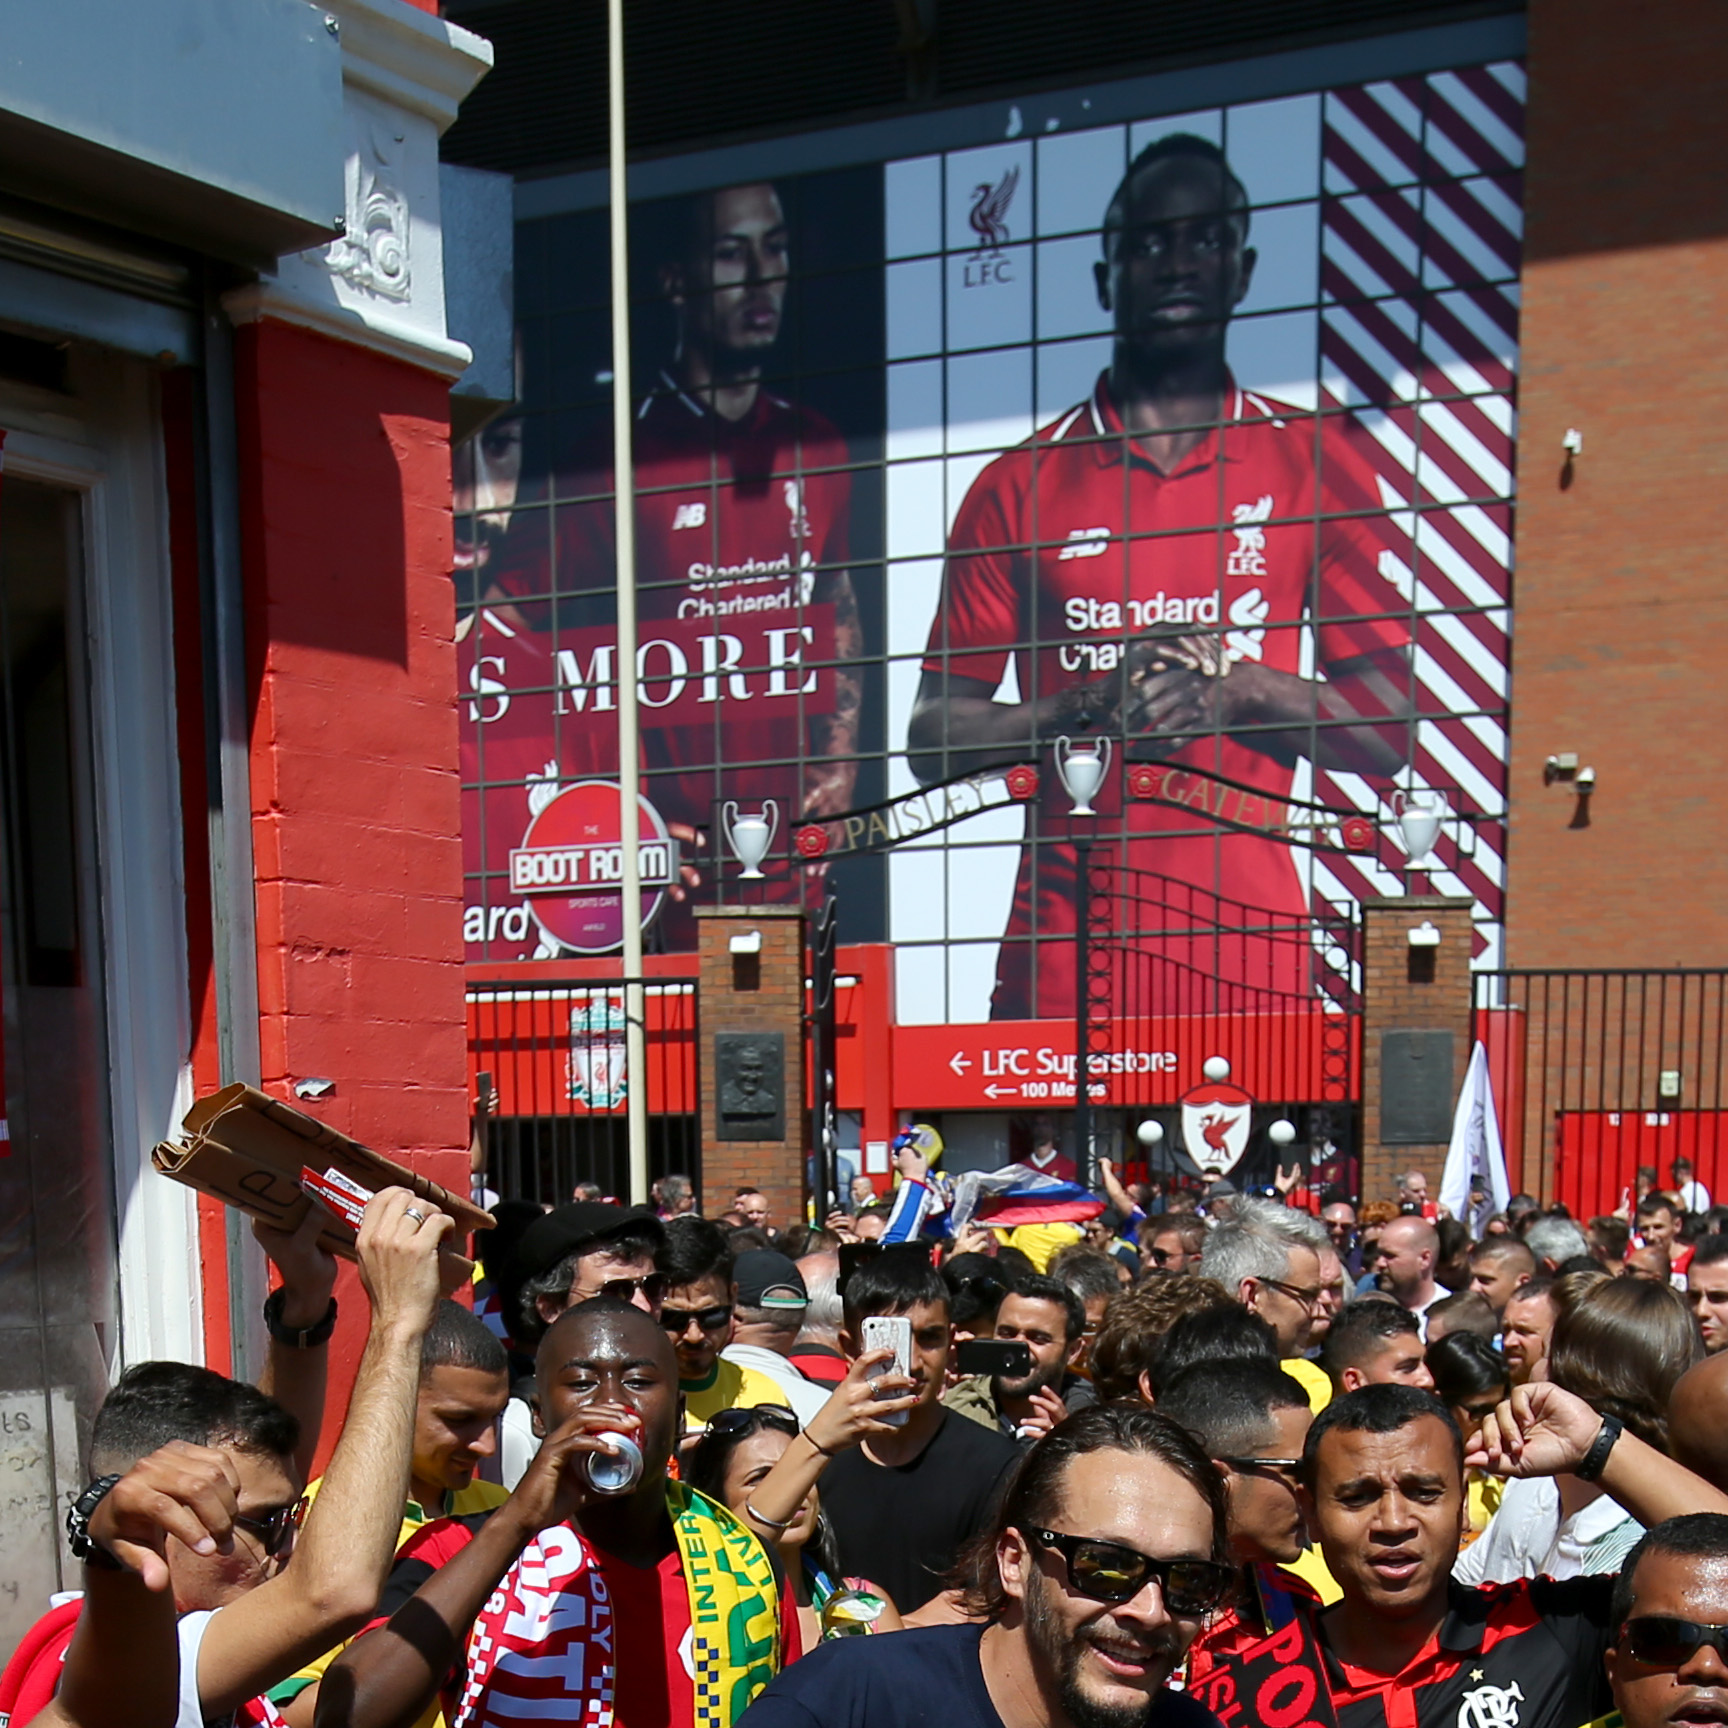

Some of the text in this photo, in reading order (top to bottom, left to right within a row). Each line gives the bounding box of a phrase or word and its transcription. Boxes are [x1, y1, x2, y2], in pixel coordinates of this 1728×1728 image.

[688, 552, 791, 592] Standard
[677, 585, 791, 621] Chartered
[1064, 588, 1220, 632] Standard
[551, 625, 818, 717] MORE
[842, 768, 1342, 850] PAISLEY GATEWAY
[515, 845, 668, 886] BOOT ROM
[981, 1045, 1177, 1081] LFC Superstore
[1019, 1081, 1107, 1098] 100 Mees
